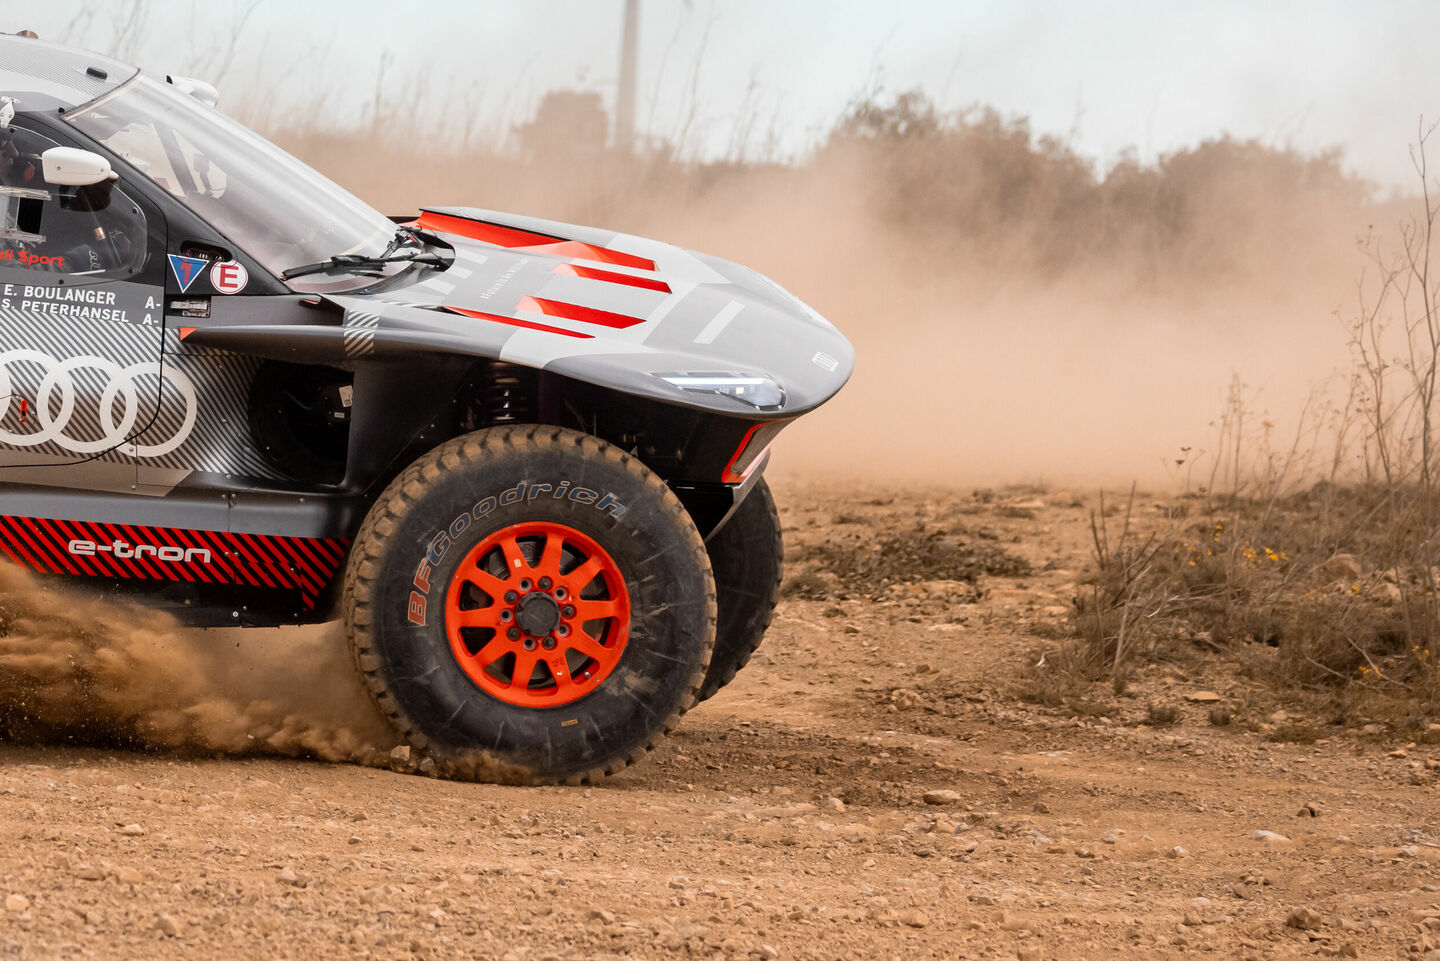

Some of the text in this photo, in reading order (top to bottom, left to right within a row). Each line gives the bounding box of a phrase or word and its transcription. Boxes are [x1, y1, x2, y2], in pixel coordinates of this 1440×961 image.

[18, 250, 65, 267] Sport
[219, 263, 239, 289] E
[3, 284, 162, 309] E. BOULANGER A-
[0, 298, 159, 325] S. PETERHANSEL A-
[68, 539, 211, 564] e-tron
[407, 480, 629, 627] BFGoodrich
